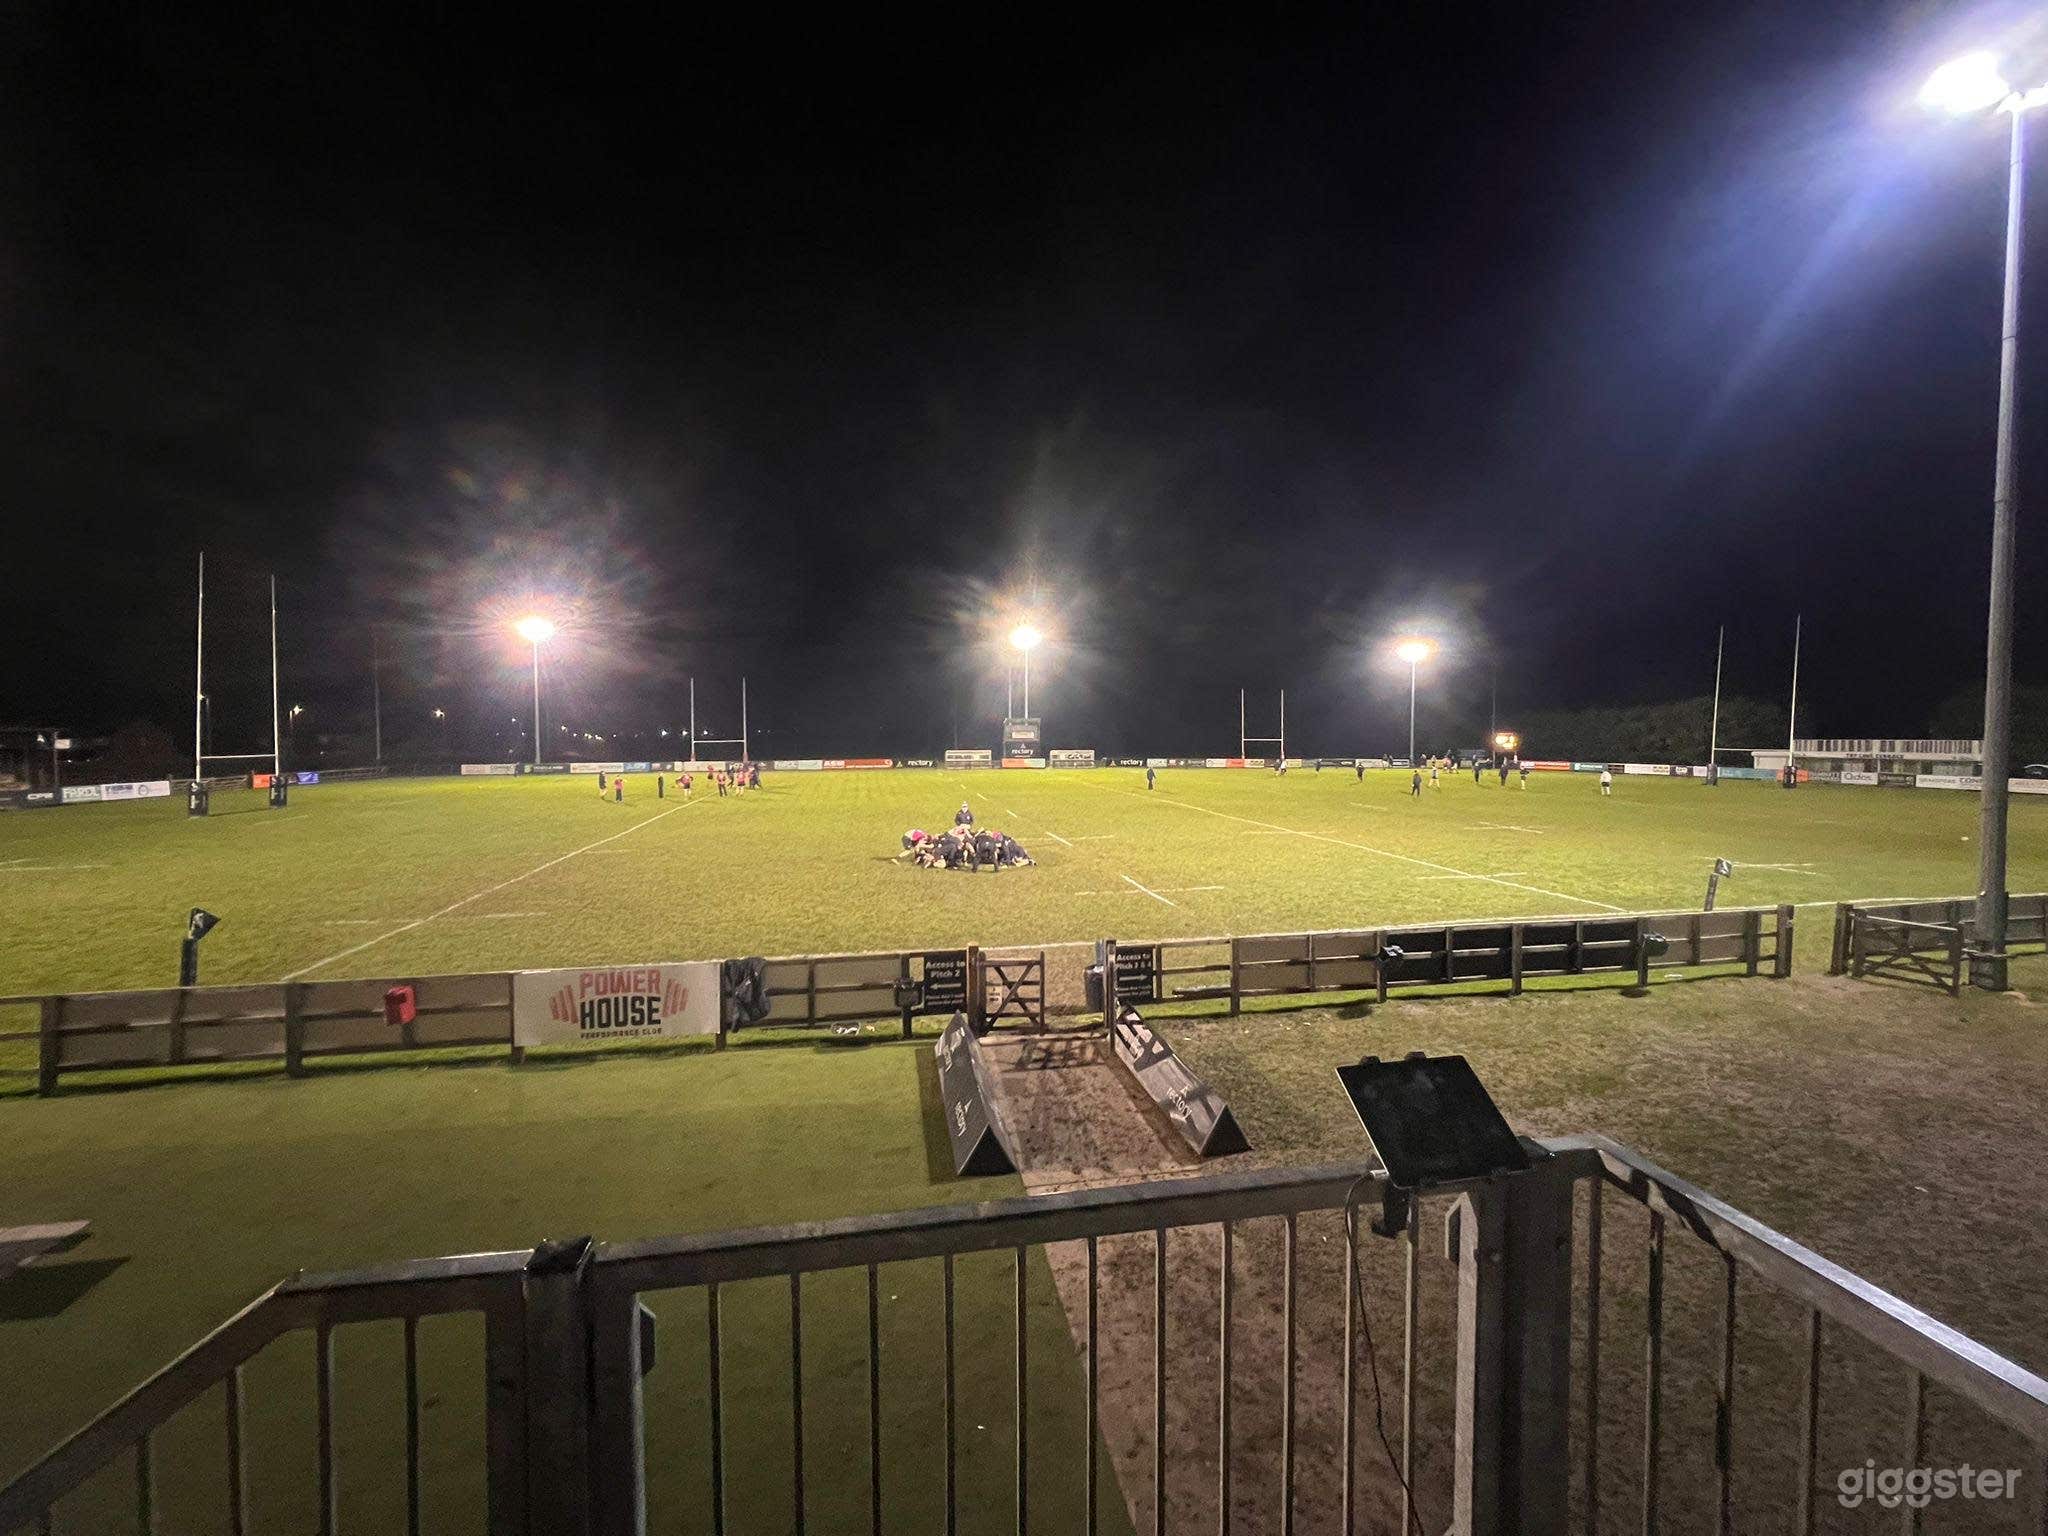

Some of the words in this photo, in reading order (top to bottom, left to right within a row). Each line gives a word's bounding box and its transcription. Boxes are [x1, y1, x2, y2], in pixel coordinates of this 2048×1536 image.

[1011, 748, 1034, 756] rectory
[907, 759, 934, 767] rectory
[1119, 759, 1143, 767] rectory
[1116, 953, 1141, 962] Access
[925, 961, 954, 970] Access
[956, 960, 966, 968] to
[930, 970, 953, 979] Pitch
[954, 969, 961, 978] 2
[579, 969, 660, 998] POWER
[579, 995, 662, 1030] HOUSE
[580, 1030, 639, 1039] PERFORMANCE
[642, 1028, 662, 1036] CLUB
[1166, 1087, 1193, 1120] rectory
